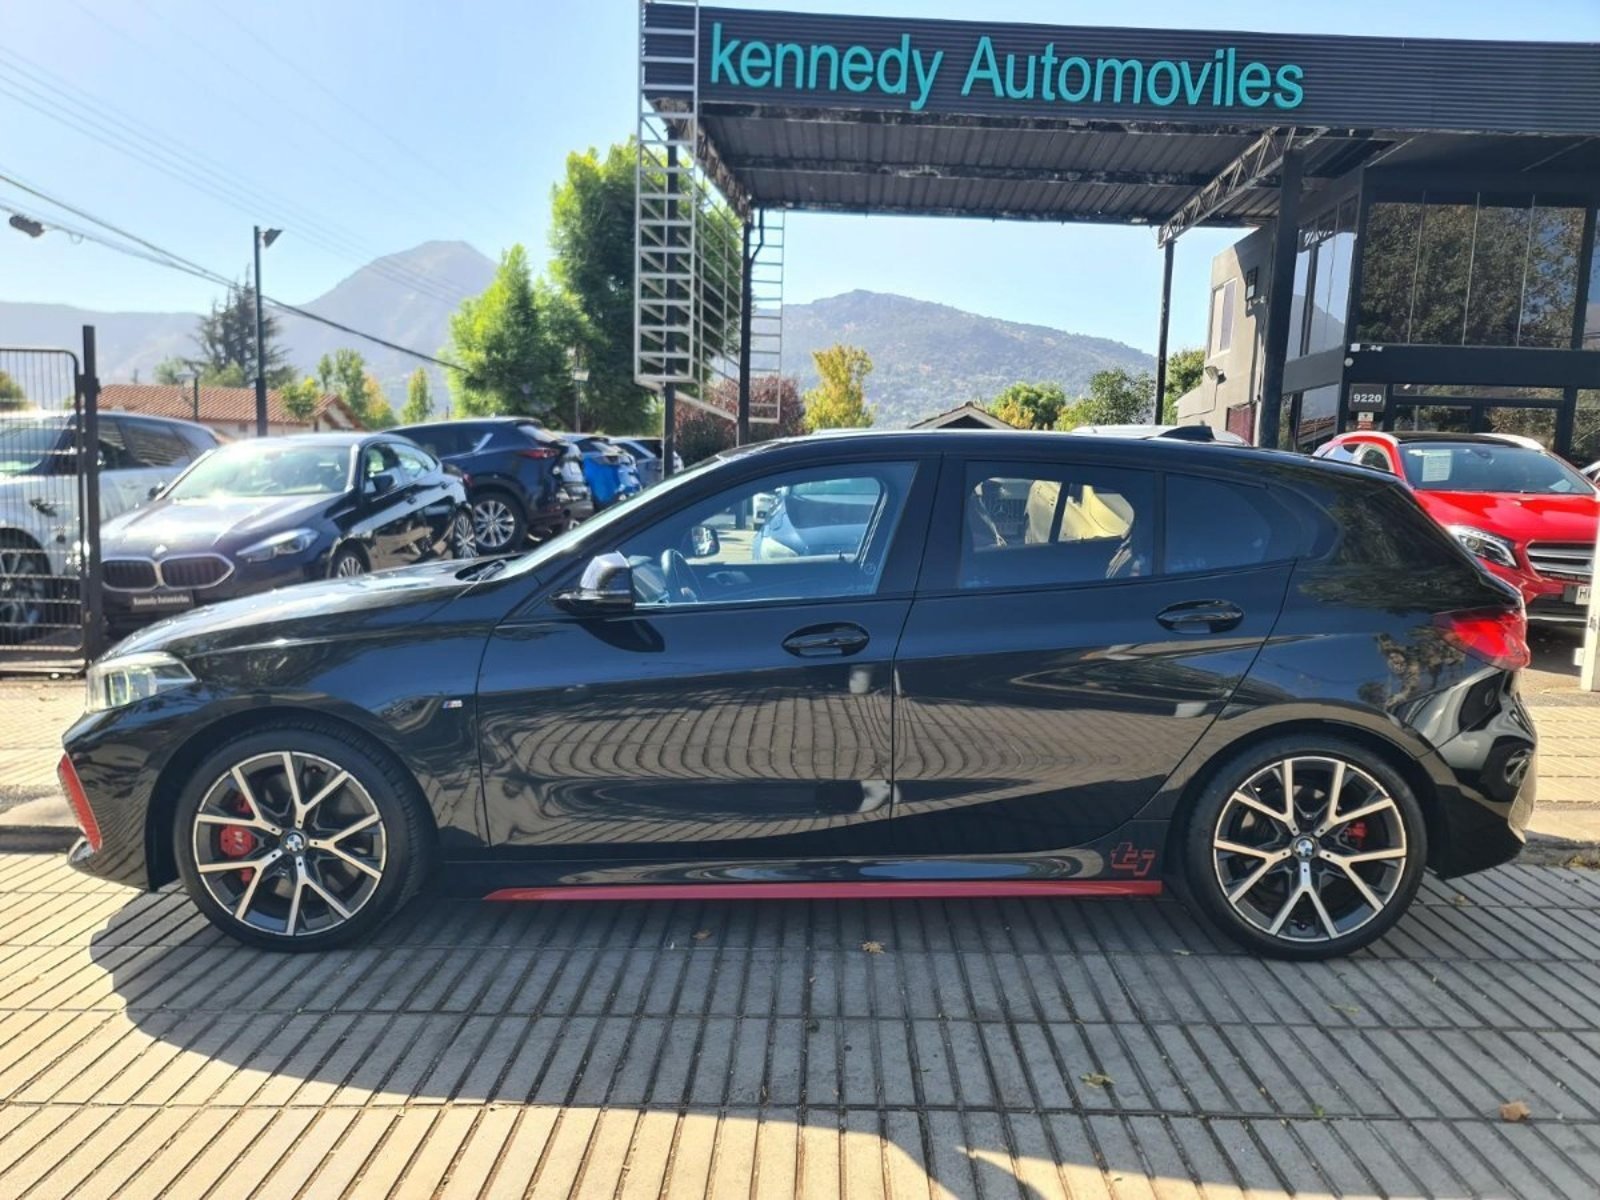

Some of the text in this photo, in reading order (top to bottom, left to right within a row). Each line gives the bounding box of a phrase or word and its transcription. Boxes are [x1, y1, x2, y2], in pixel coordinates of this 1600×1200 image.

[710, 22, 1305, 112] kennedy Automoviles
[1353, 393, 1382, 403] 9220
